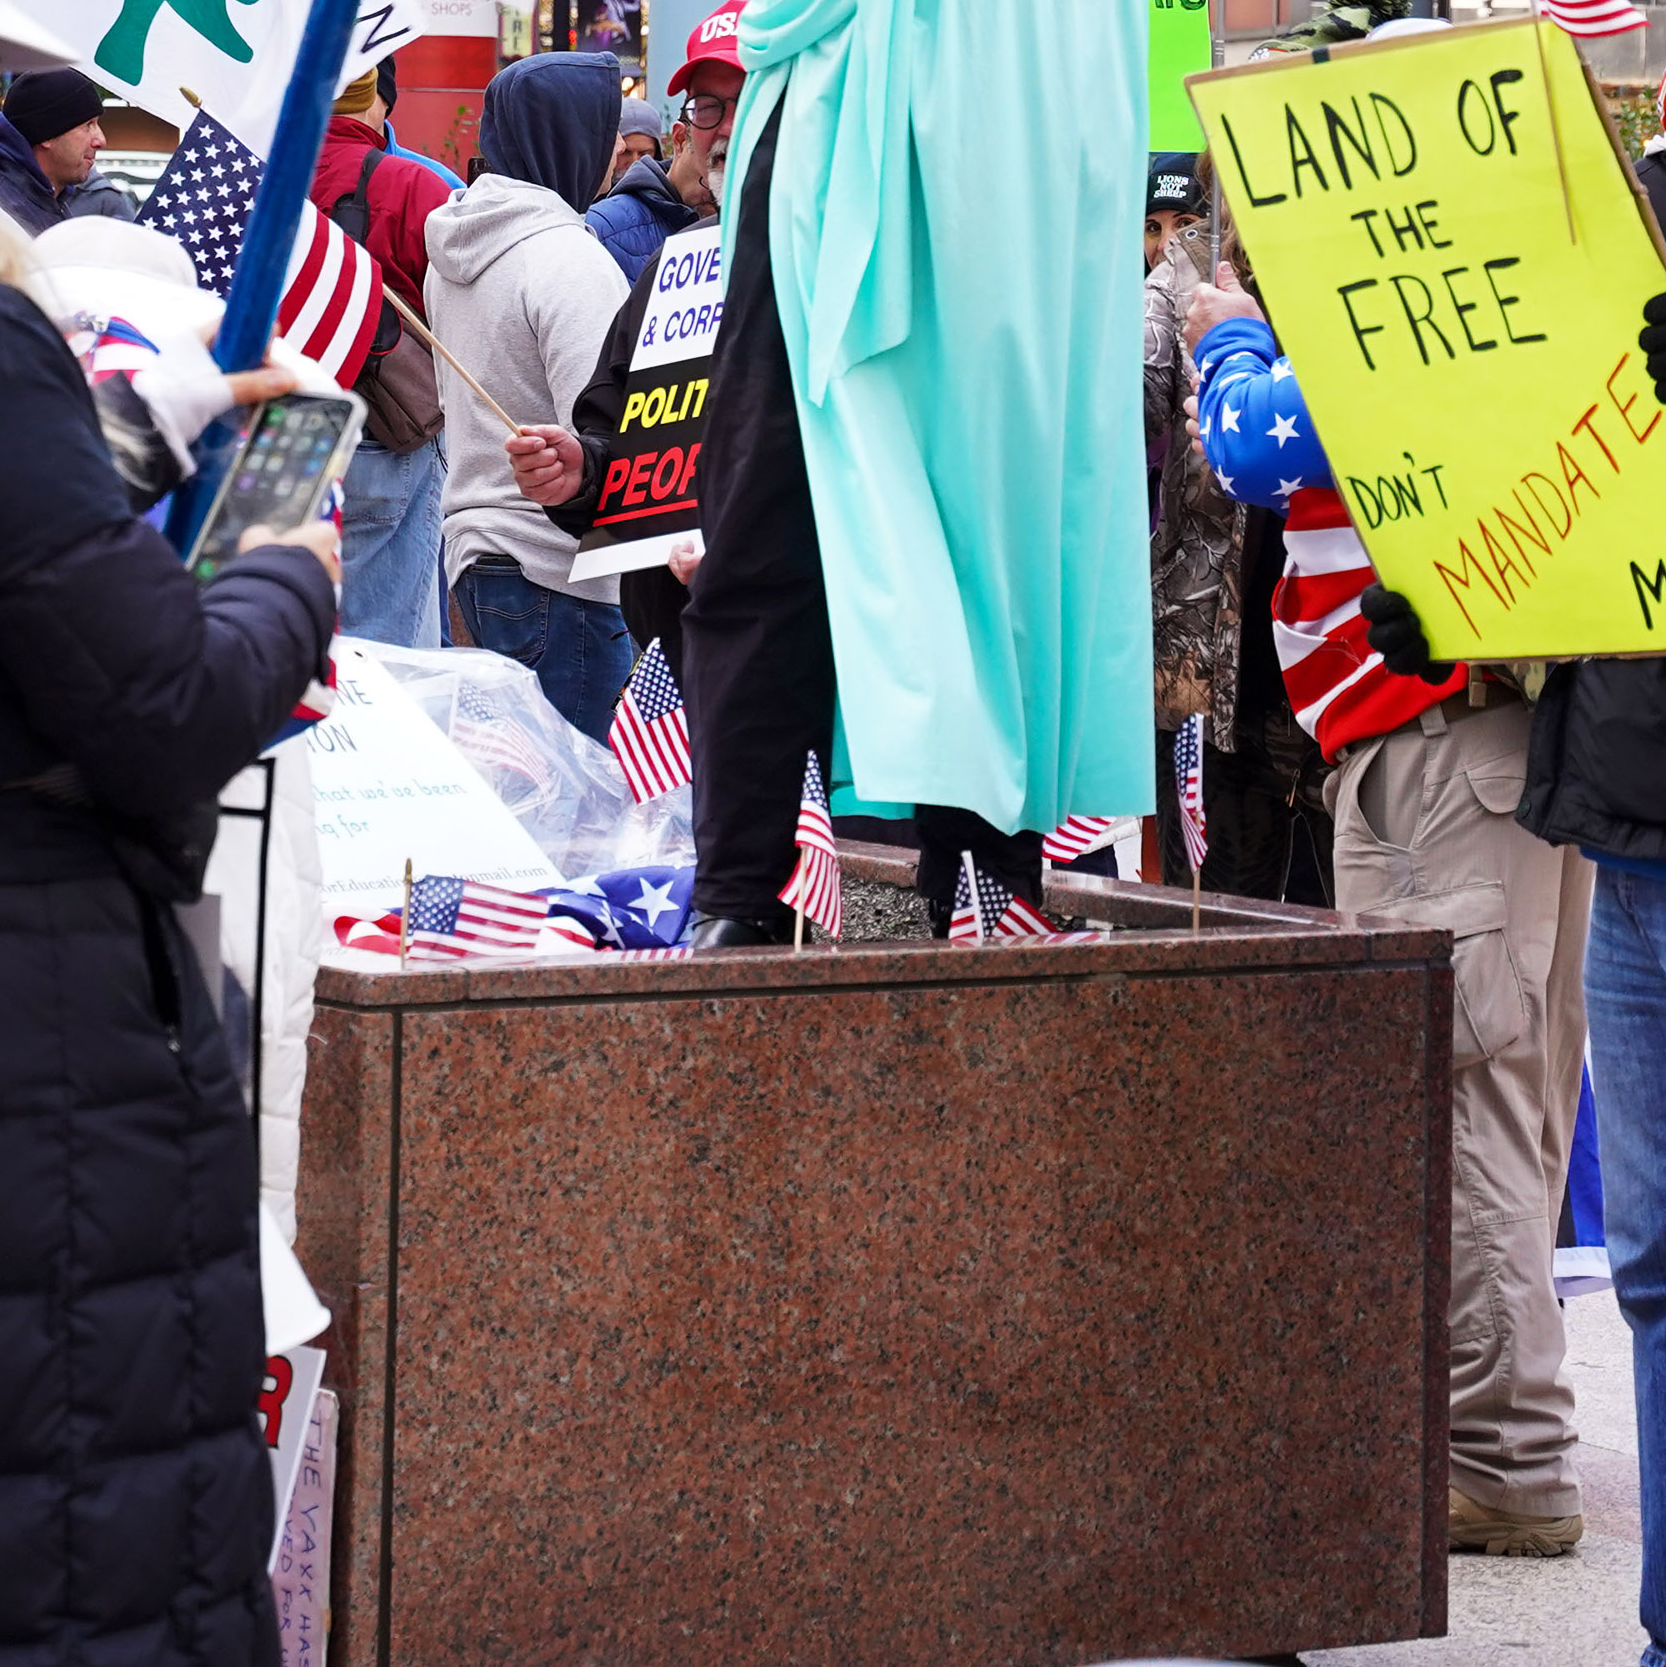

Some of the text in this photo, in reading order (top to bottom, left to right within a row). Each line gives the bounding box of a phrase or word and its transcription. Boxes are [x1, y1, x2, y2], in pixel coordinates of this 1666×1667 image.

[431, 2, 472, 16] SHOPS
[701, 12, 739, 44] US
[1221, 68, 1526, 210] LAND OF
[1157, 175, 1190, 187] LIONS
[1159, 181, 1183, 193] NOT
[1153, 188, 1187, 200] SHEEP
[1351, 199, 1454, 259] THE
[1337, 256, 1548, 372] FREE
[642, 322, 657, 347] &
[1346, 451, 1453, 531] DON'T
[1433, 352, 1665, 640] MANDATE
[418, 778, 468, 796] been
